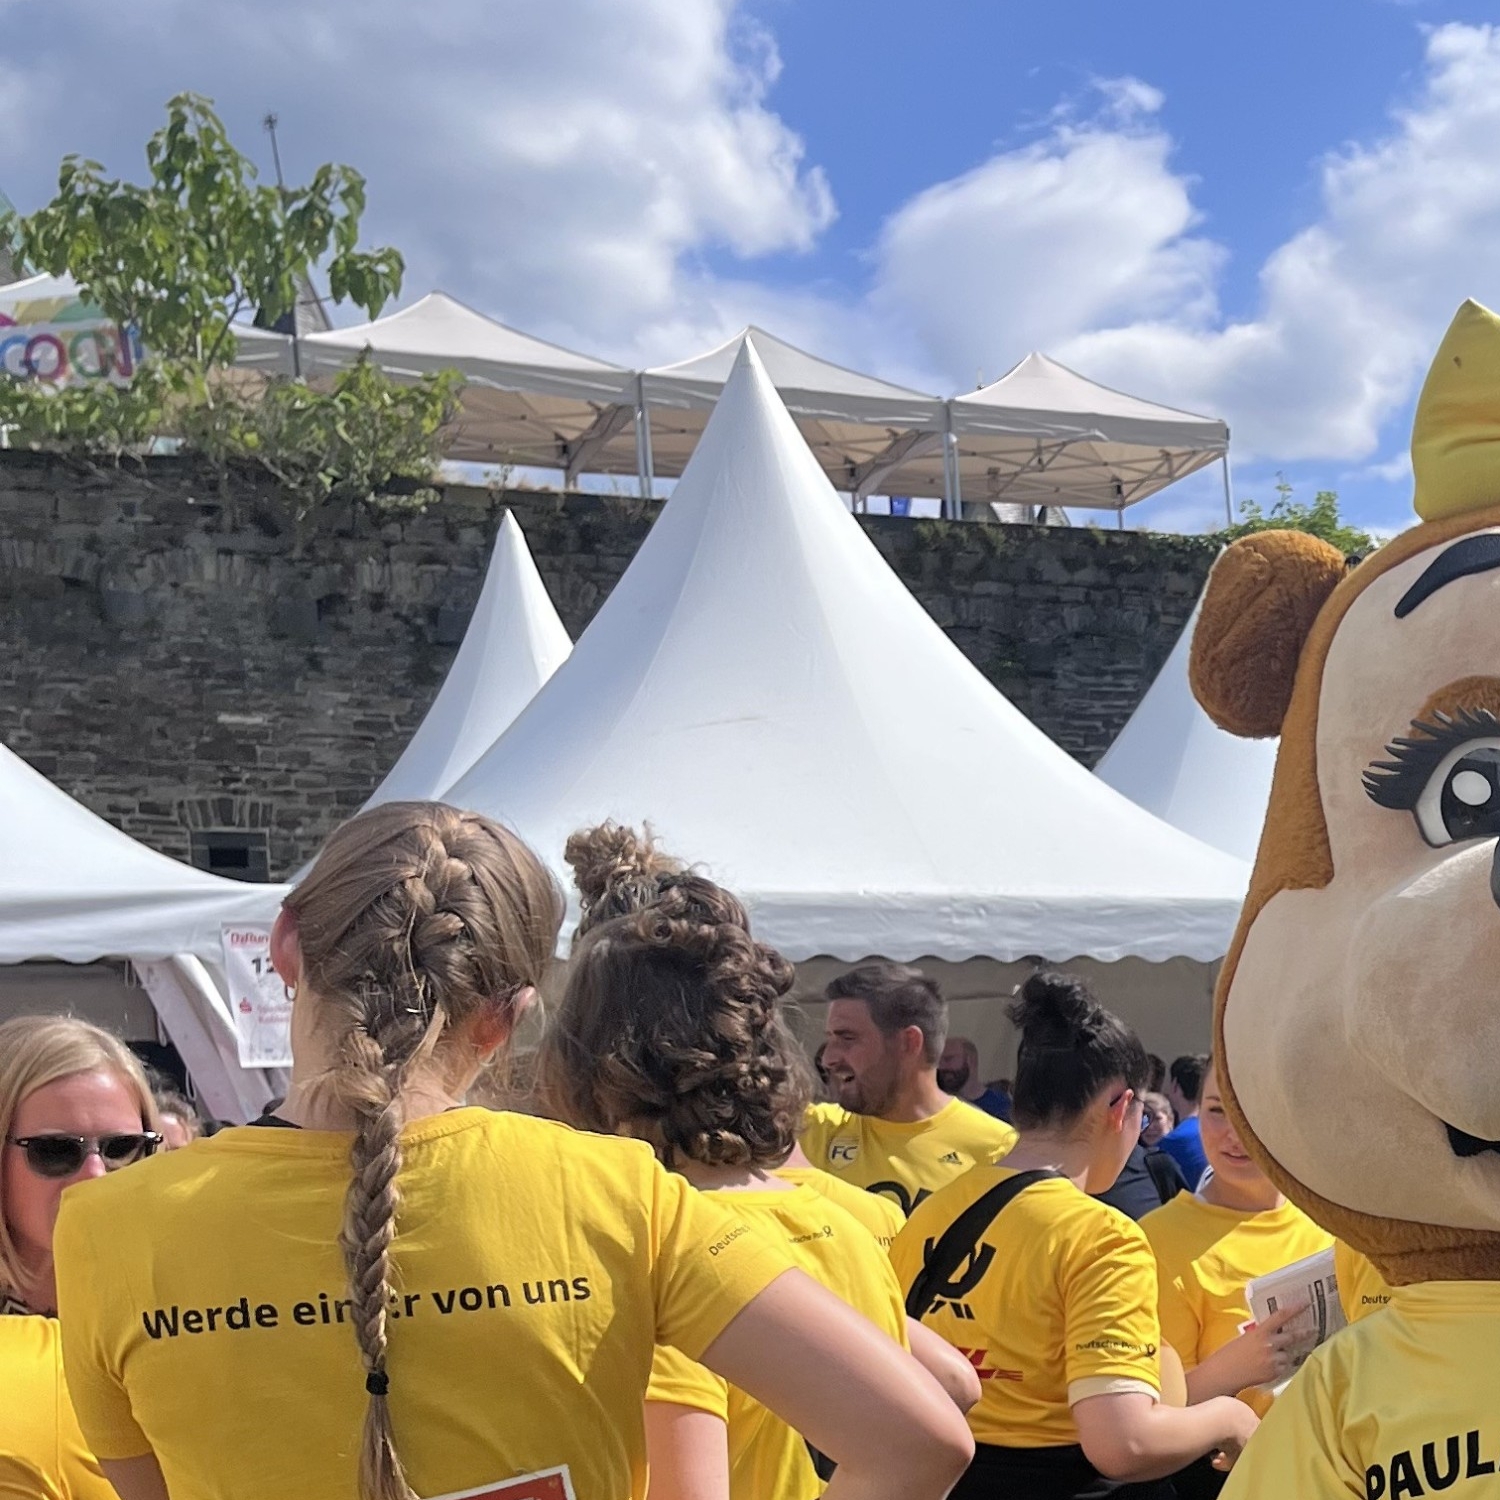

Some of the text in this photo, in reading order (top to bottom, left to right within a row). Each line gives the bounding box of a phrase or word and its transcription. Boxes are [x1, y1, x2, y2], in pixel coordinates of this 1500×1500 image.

[832, 1145, 857, 1160] FC
[142, 1276, 592, 1339] Werde ein:r von uns
